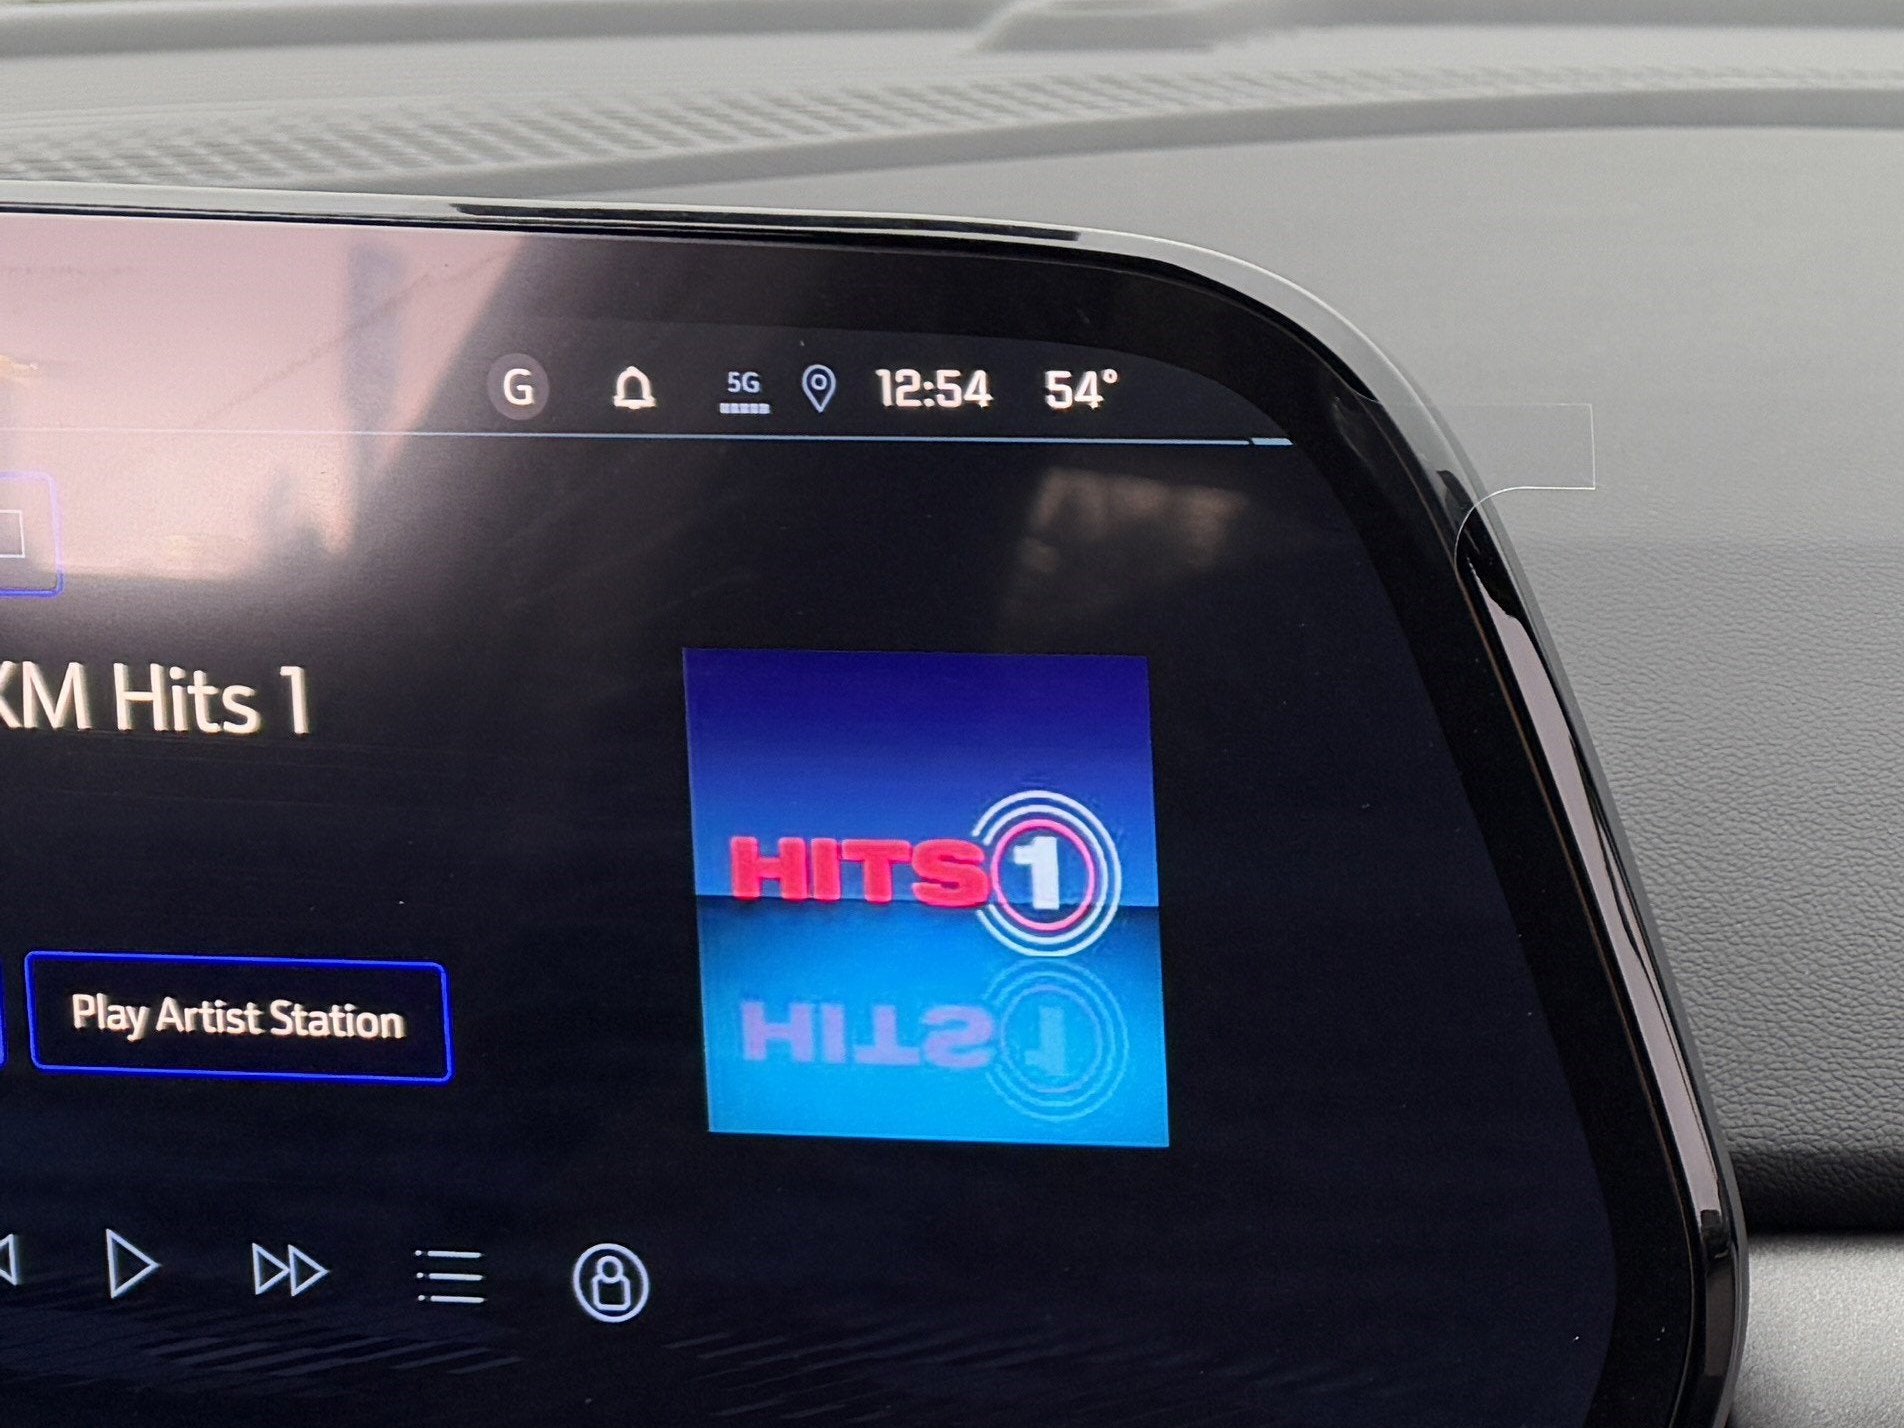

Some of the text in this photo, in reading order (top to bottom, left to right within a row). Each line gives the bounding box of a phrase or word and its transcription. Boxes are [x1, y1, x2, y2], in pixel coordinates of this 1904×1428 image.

[502, 367, 1118, 409] G 5G 12:54 54°
[113, 662, 262, 734] Hits
[279, 665, 310, 734] 1
[730, 836, 1060, 910] HITS 1
[72, 992, 406, 1042] Play Artist Station
